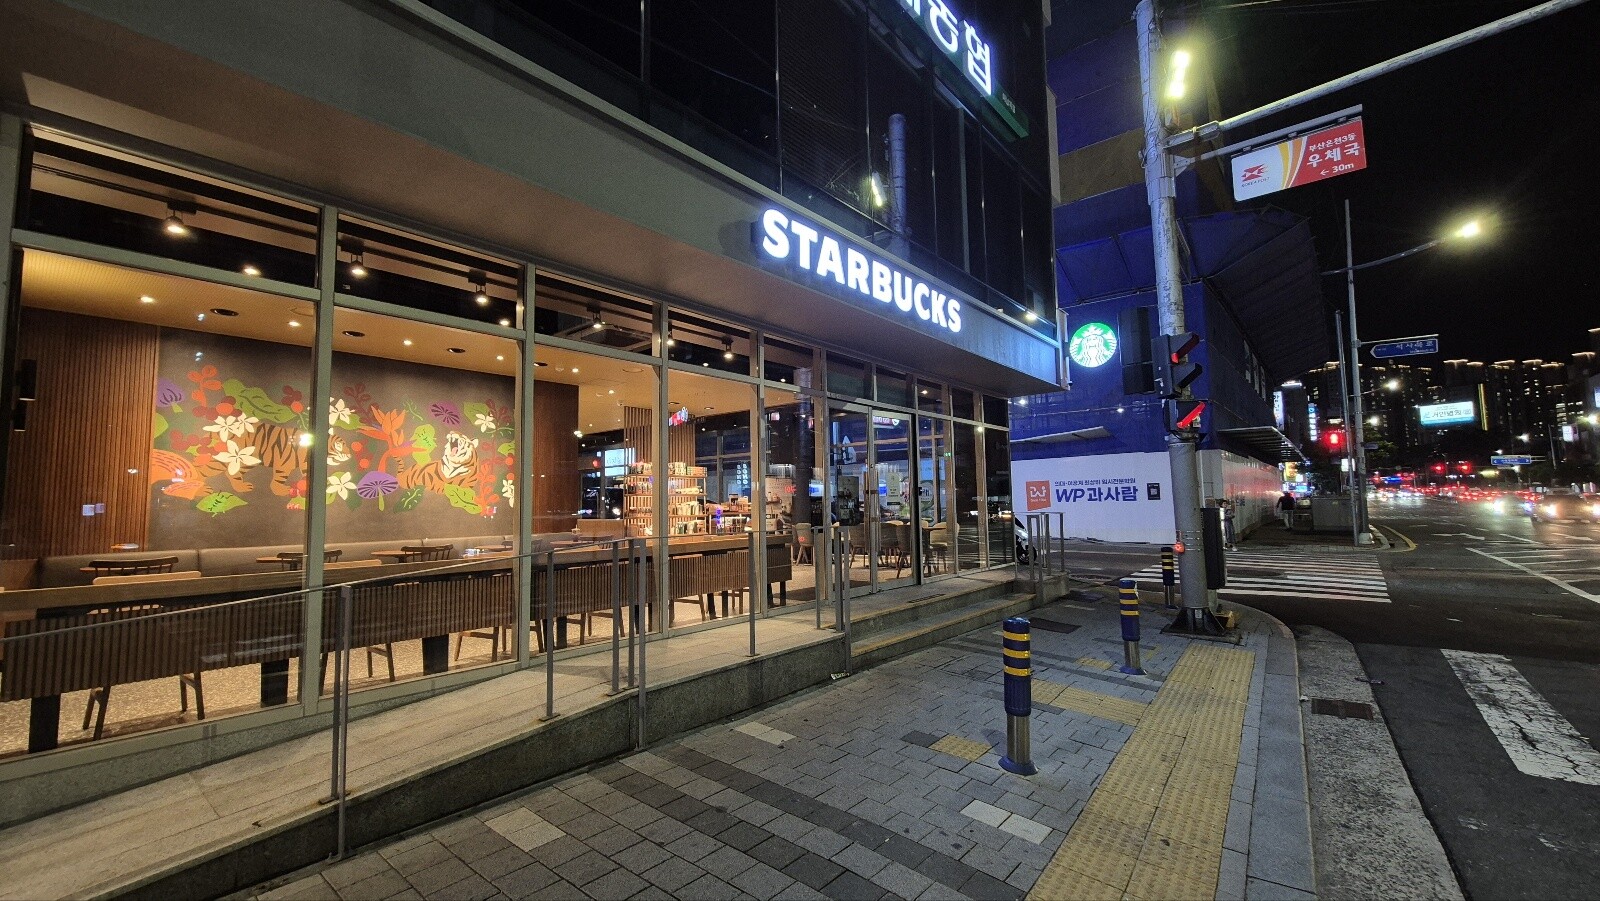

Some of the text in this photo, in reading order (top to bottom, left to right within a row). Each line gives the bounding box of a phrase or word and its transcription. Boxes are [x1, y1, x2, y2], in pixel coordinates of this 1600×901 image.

[896, 0, 991, 95] 농협
[1306, 142, 1360, 168] 우체국
[1332, 163, 1354, 174] 30m
[762, 208, 962, 333] STARBUCKS
